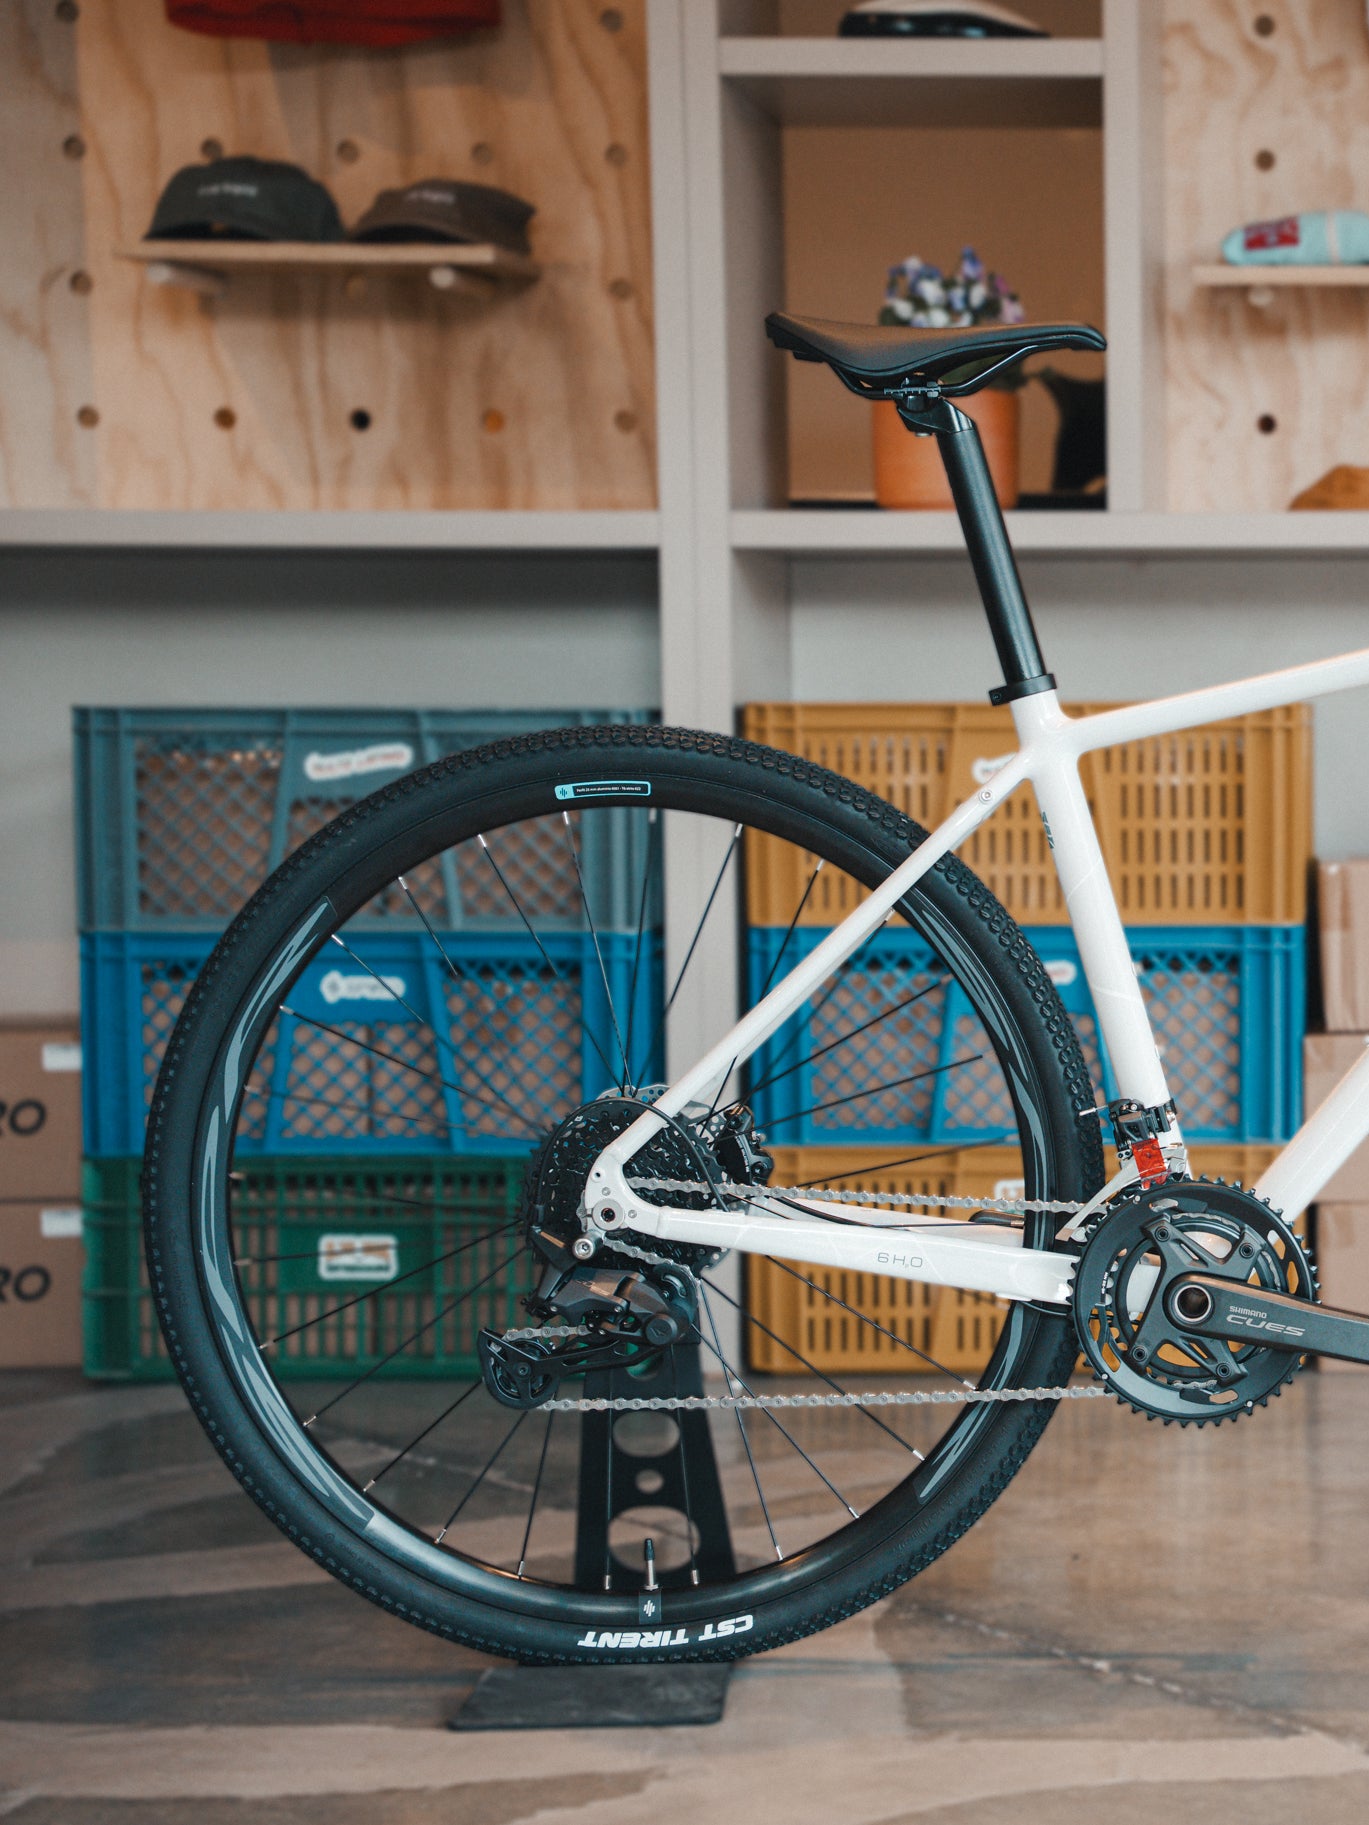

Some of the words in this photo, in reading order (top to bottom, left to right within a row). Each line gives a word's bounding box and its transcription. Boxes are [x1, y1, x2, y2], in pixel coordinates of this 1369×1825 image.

[1229, 1305, 1268, 1319] SHIMANO
[1226, 1314, 1306, 1337] CUES
[577, 1628, 689, 1649] TIRENT
[698, 1614, 754, 1641] CST
